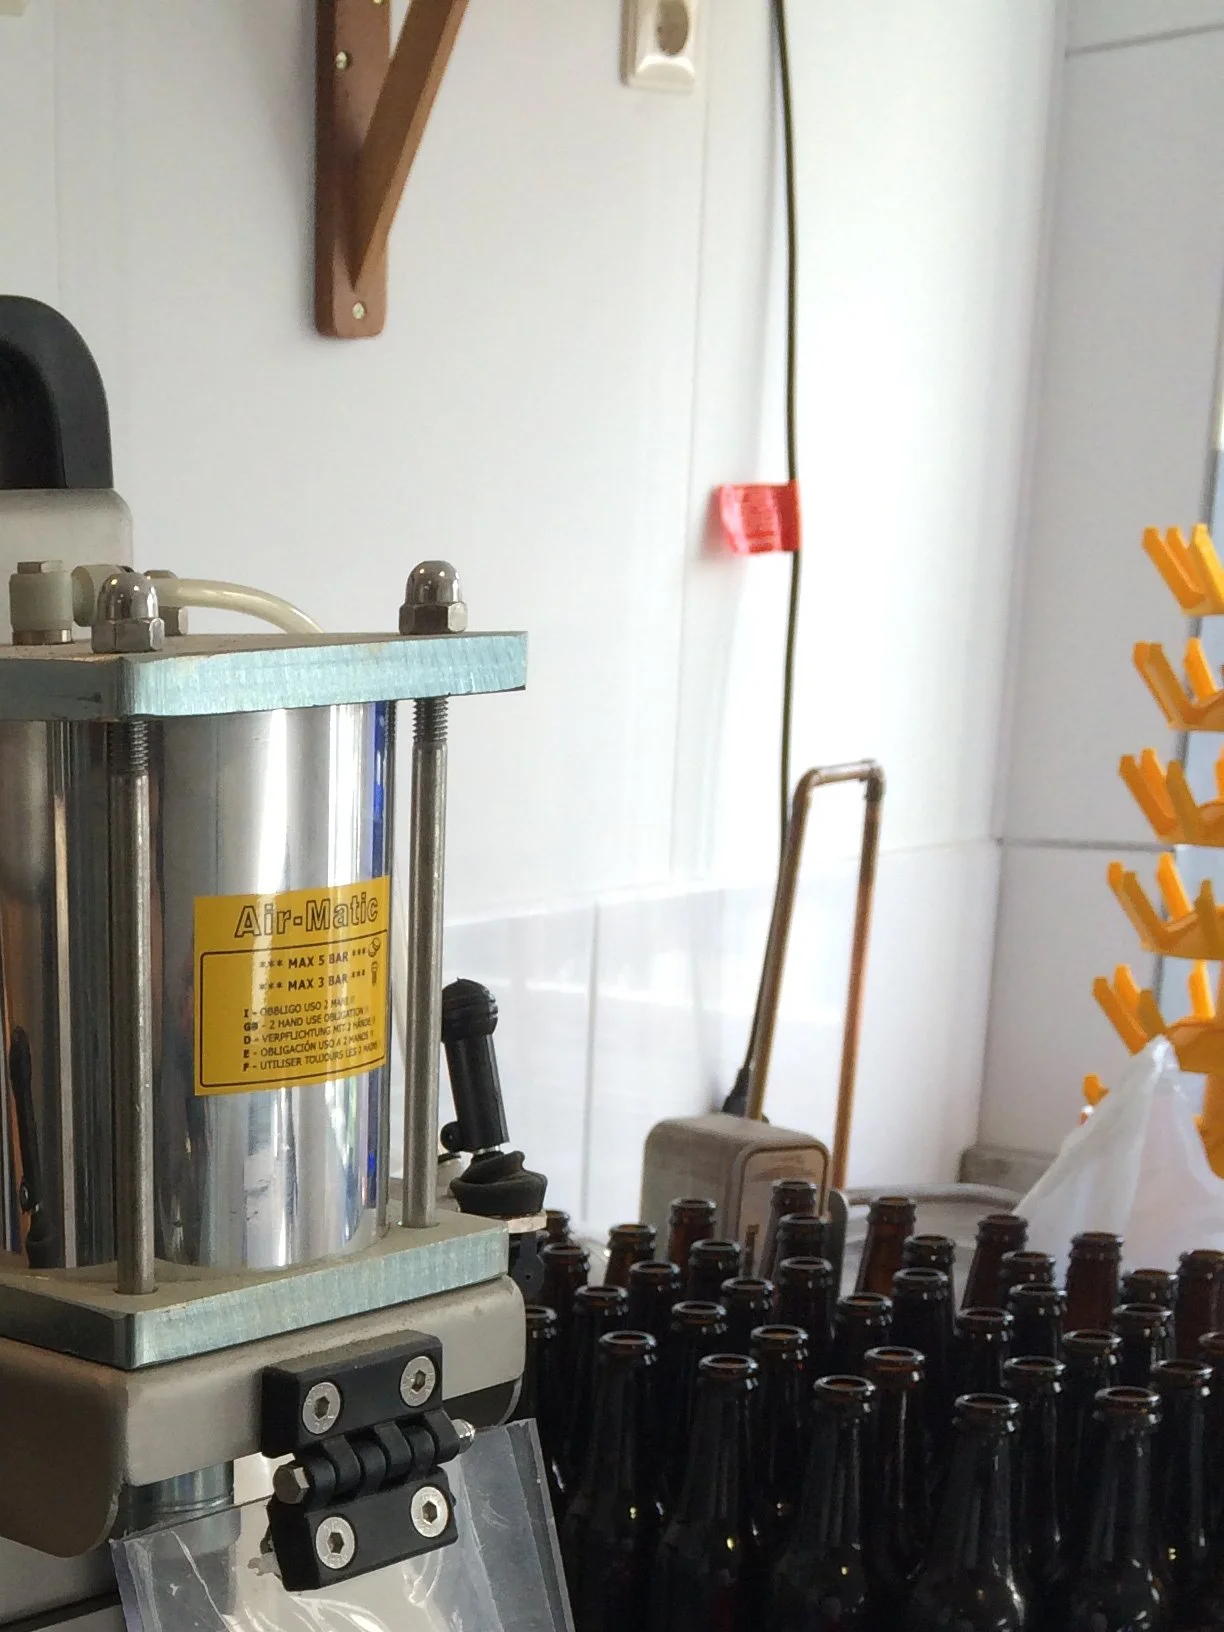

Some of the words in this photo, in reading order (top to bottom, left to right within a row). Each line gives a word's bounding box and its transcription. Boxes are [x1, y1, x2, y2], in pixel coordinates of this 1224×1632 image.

[234, 891, 378, 938] Air-Matic
[288, 955, 314, 970] MAX
[318, 953, 325, 967] 5
[328, 951, 348, 966] BAR
[288, 977, 314, 992] MAX
[317, 976, 325, 989] 3
[328, 973, 348, 987] BAR
[243, 1008, 249, 1018] I
[260, 1003, 302, 1018] OBBLIGO
[304, 1001, 321, 1012] USO
[269, 1019, 276, 1030] 2
[278, 1017, 303, 1029] HAND
[306, 1013, 322, 1025] USE
[243, 1035, 251, 1045] D
[262, 1025, 331, 1043] VERPFLICHTUNG
[260, 1039, 318, 1057] OBLIGACIÓN
[319, 1038, 335, 1050] USO
[242, 1062, 250, 1073] F
[260, 1056, 303, 1071] UTILISER
